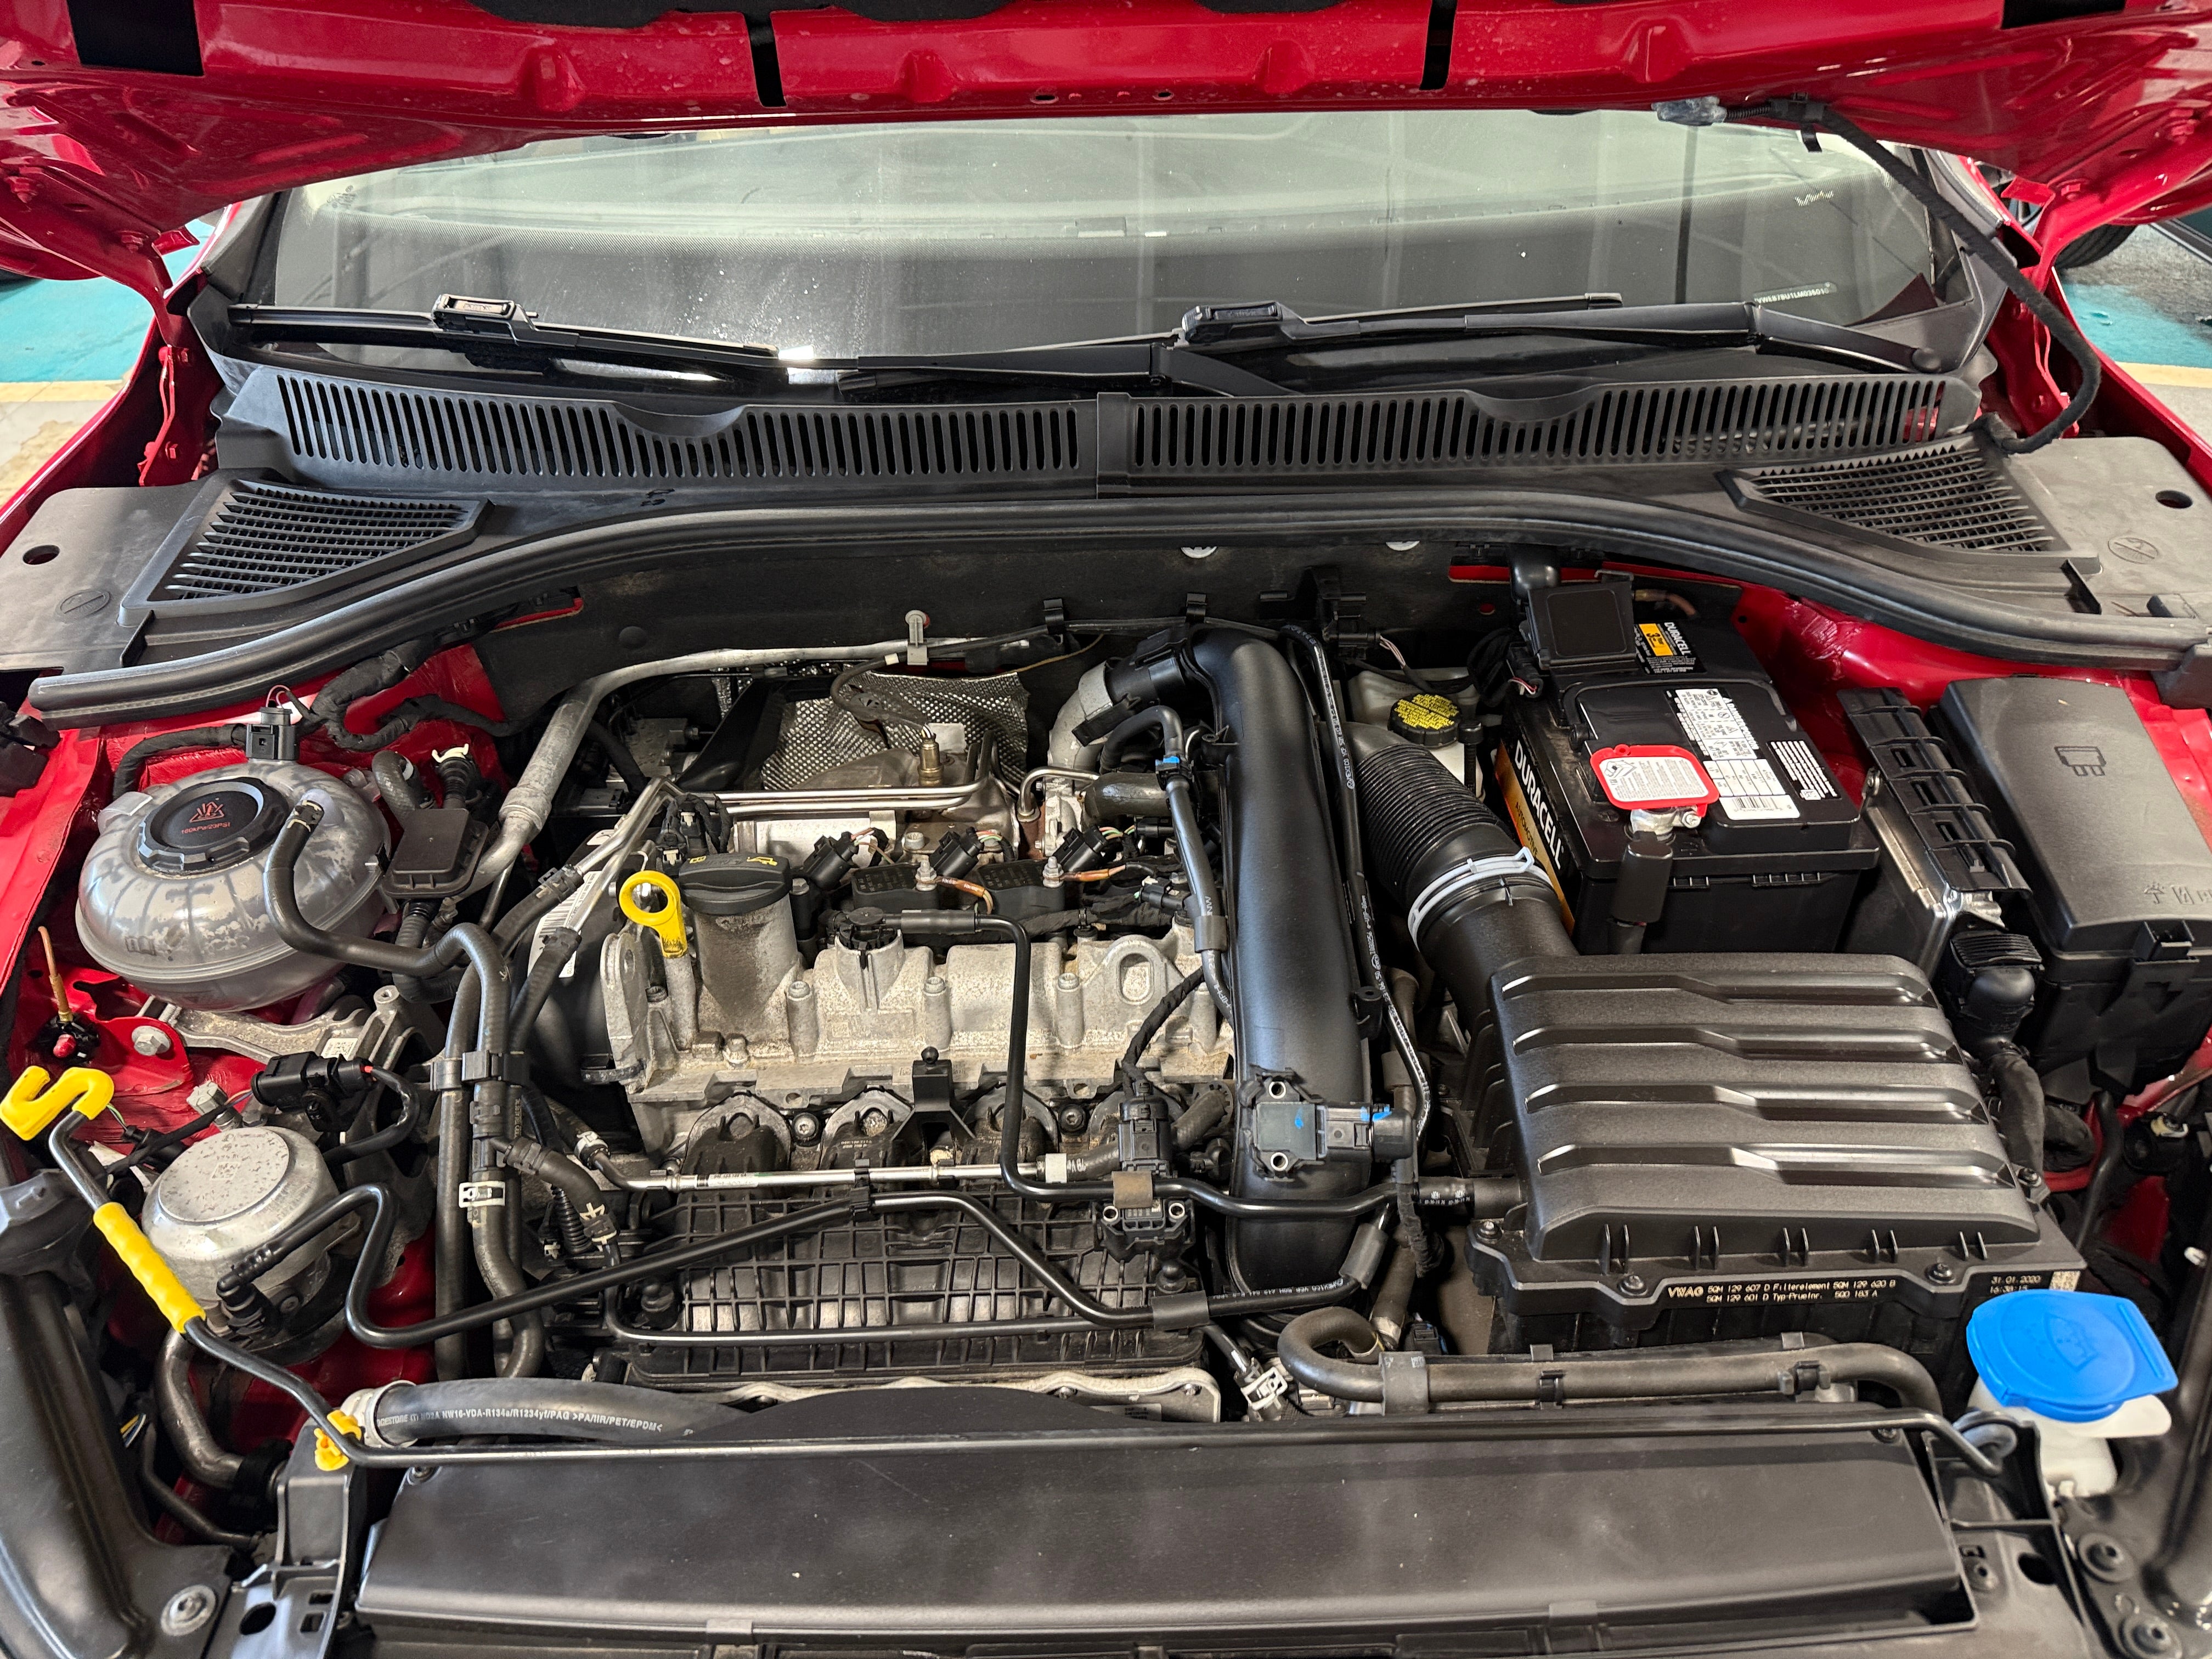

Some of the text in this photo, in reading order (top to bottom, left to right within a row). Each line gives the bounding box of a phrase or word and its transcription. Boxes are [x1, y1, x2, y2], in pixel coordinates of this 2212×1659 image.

[1664, 622, 1691, 656] DURACELL
[1515, 740, 1562, 870] DURACELL
[1515, 801, 1538, 856] AUTOMOTIVE
[1773, 1282, 1830, 1291] Filterelement
